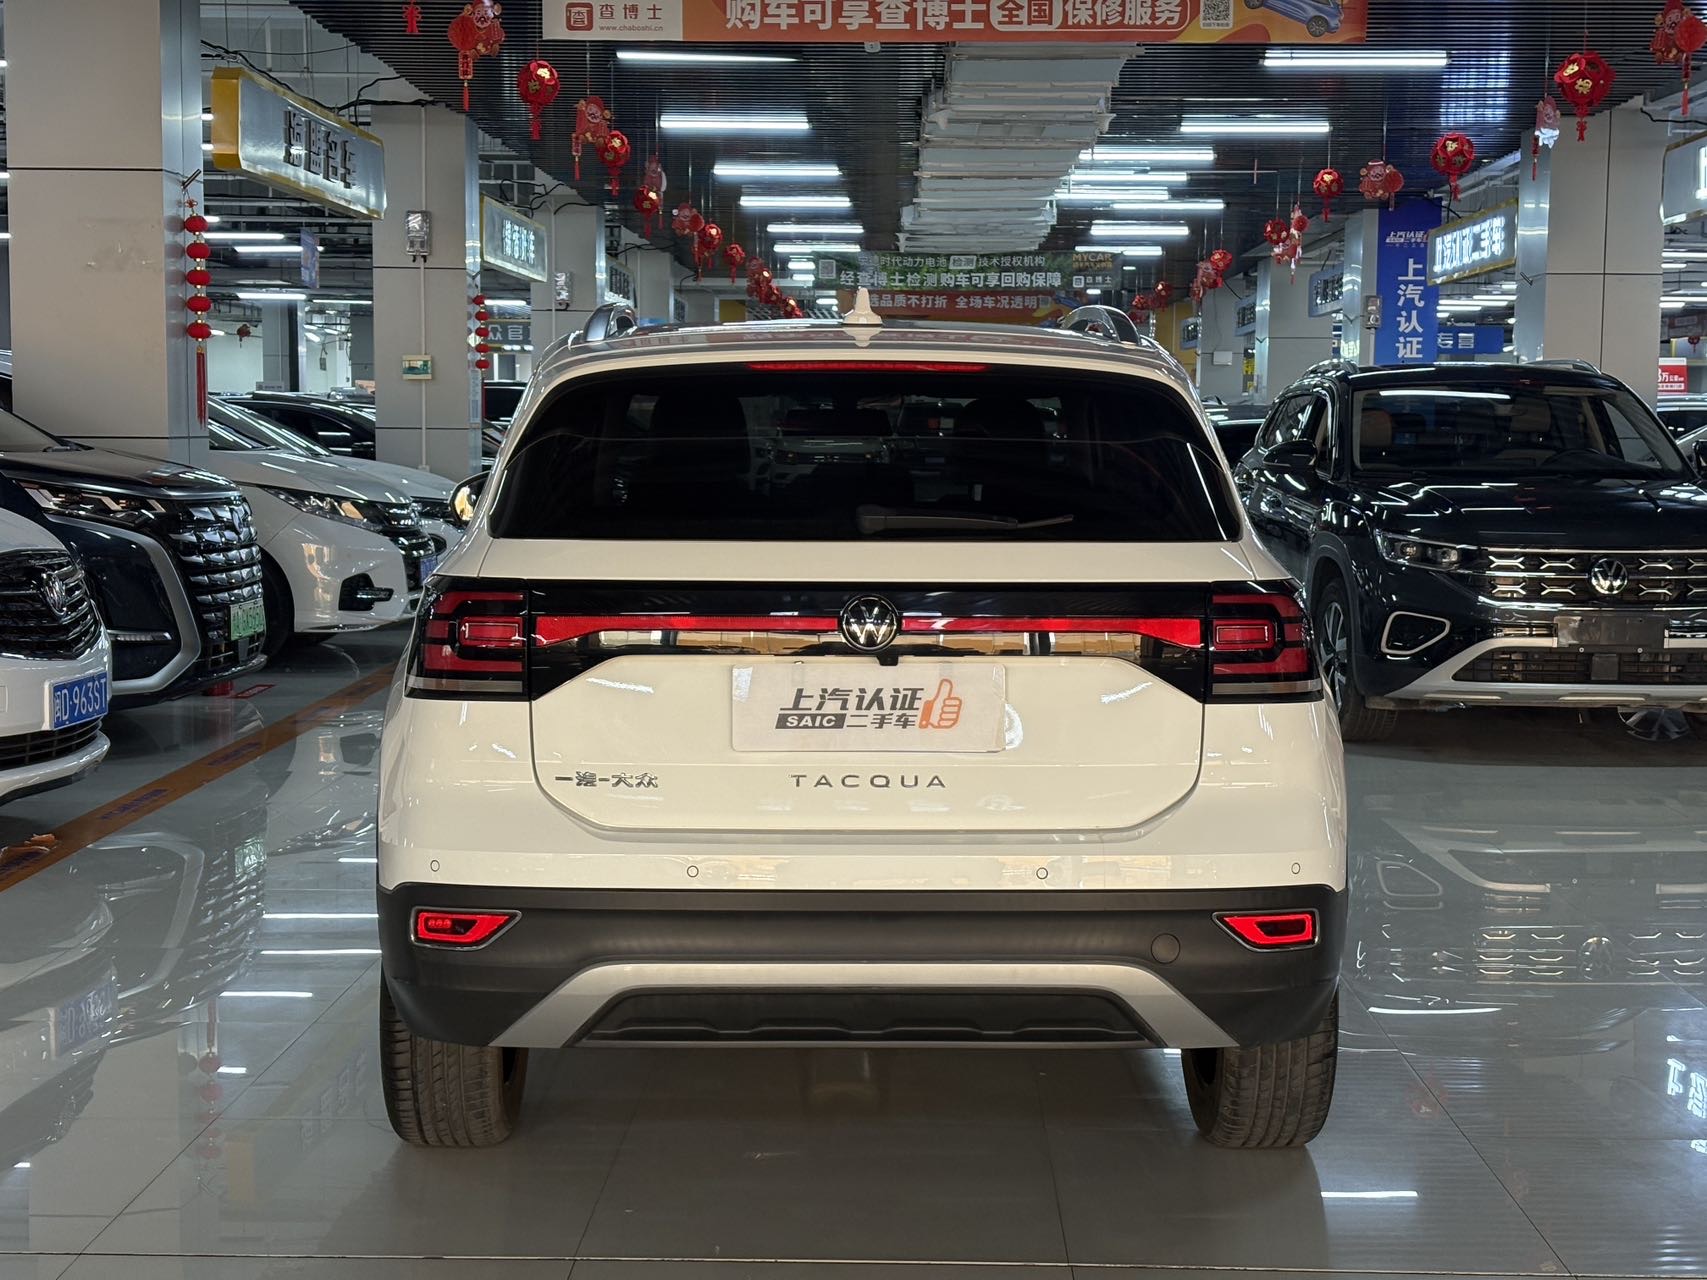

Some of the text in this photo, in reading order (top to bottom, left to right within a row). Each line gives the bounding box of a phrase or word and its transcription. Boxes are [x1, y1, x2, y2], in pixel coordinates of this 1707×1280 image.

[599, 4, 662, 19] 查博士
[1072, 253, 1112, 261] MYCAR
[839, 271, 1062, 288] 经查博士检测购车可享回购保障
[1395, 258, 1425, 358] 上汽认证
[780, 688, 924, 711] 上汽认证
[786, 713, 918, 729] SAIC 二手车
[555, 771, 658, 788] 一汽-大众
[791, 774, 946, 788] TACQUA
